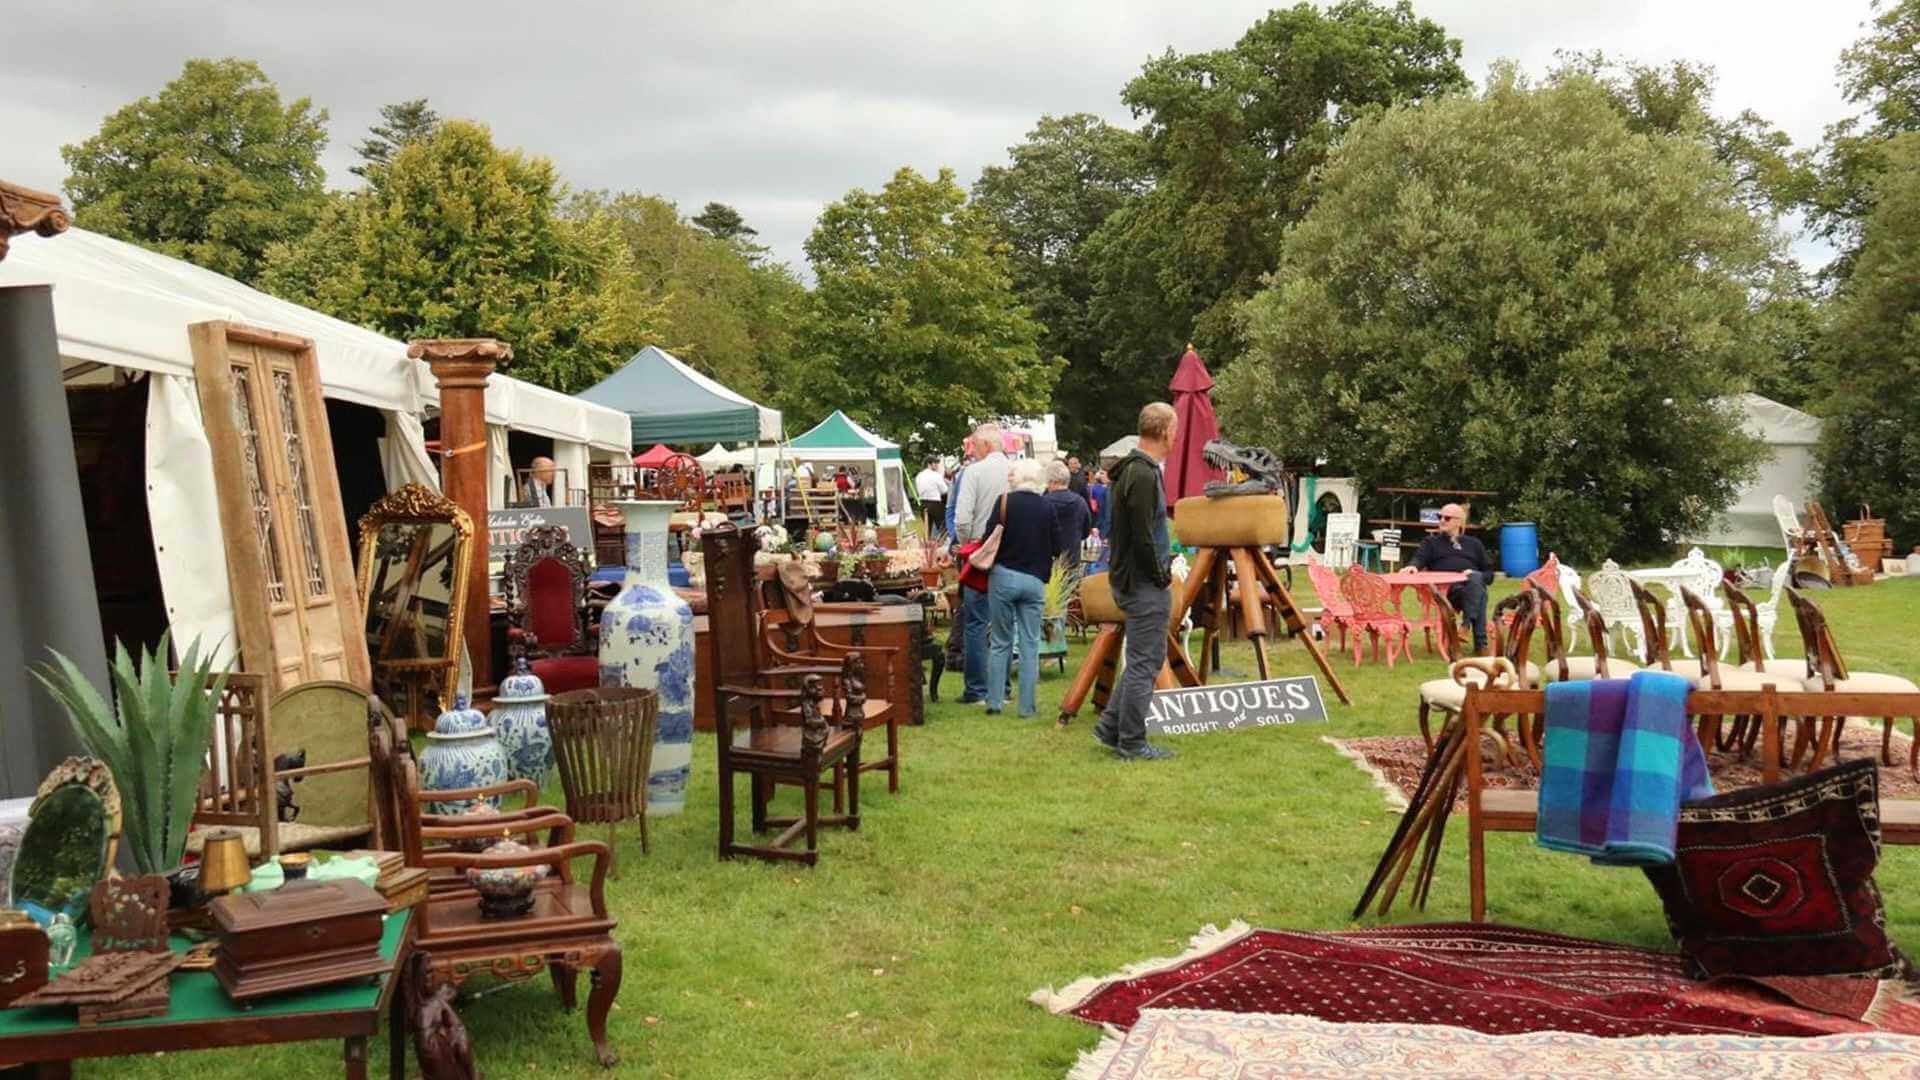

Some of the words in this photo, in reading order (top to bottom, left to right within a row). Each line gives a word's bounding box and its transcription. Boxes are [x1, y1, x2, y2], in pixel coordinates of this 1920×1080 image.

[1144, 683, 1310, 726] ANTIQUES
[1162, 721, 1218, 734] BOUGHT
[1256, 713, 1295, 727] SOLD
